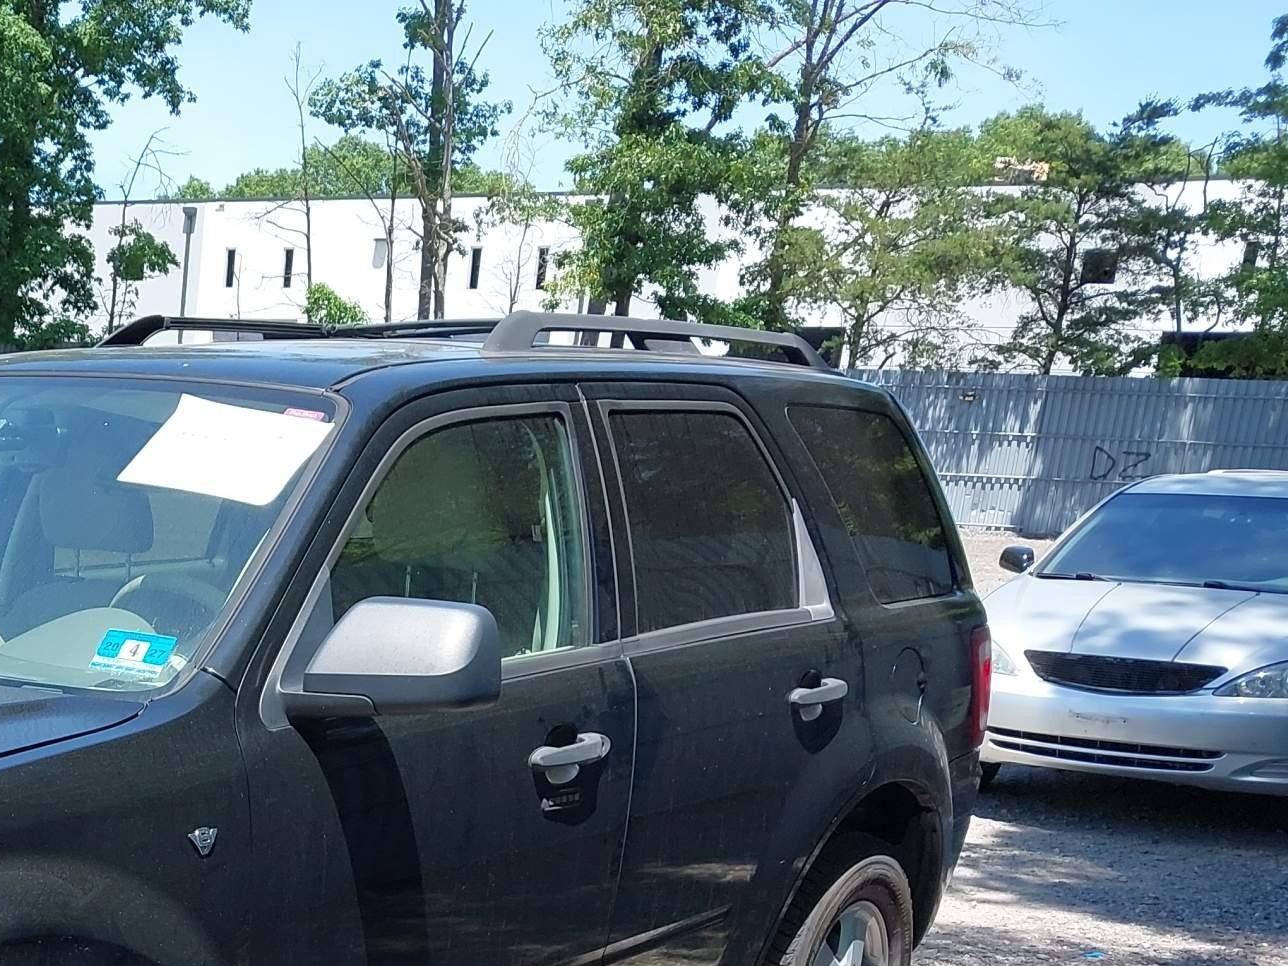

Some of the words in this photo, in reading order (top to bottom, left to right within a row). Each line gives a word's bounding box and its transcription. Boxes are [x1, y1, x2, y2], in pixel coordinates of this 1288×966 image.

[1090, 446, 1151, 480] DZ
[102, 641, 120, 652] 20
[129, 643, 141, 657] 4
[149, 649, 167, 658] 27
